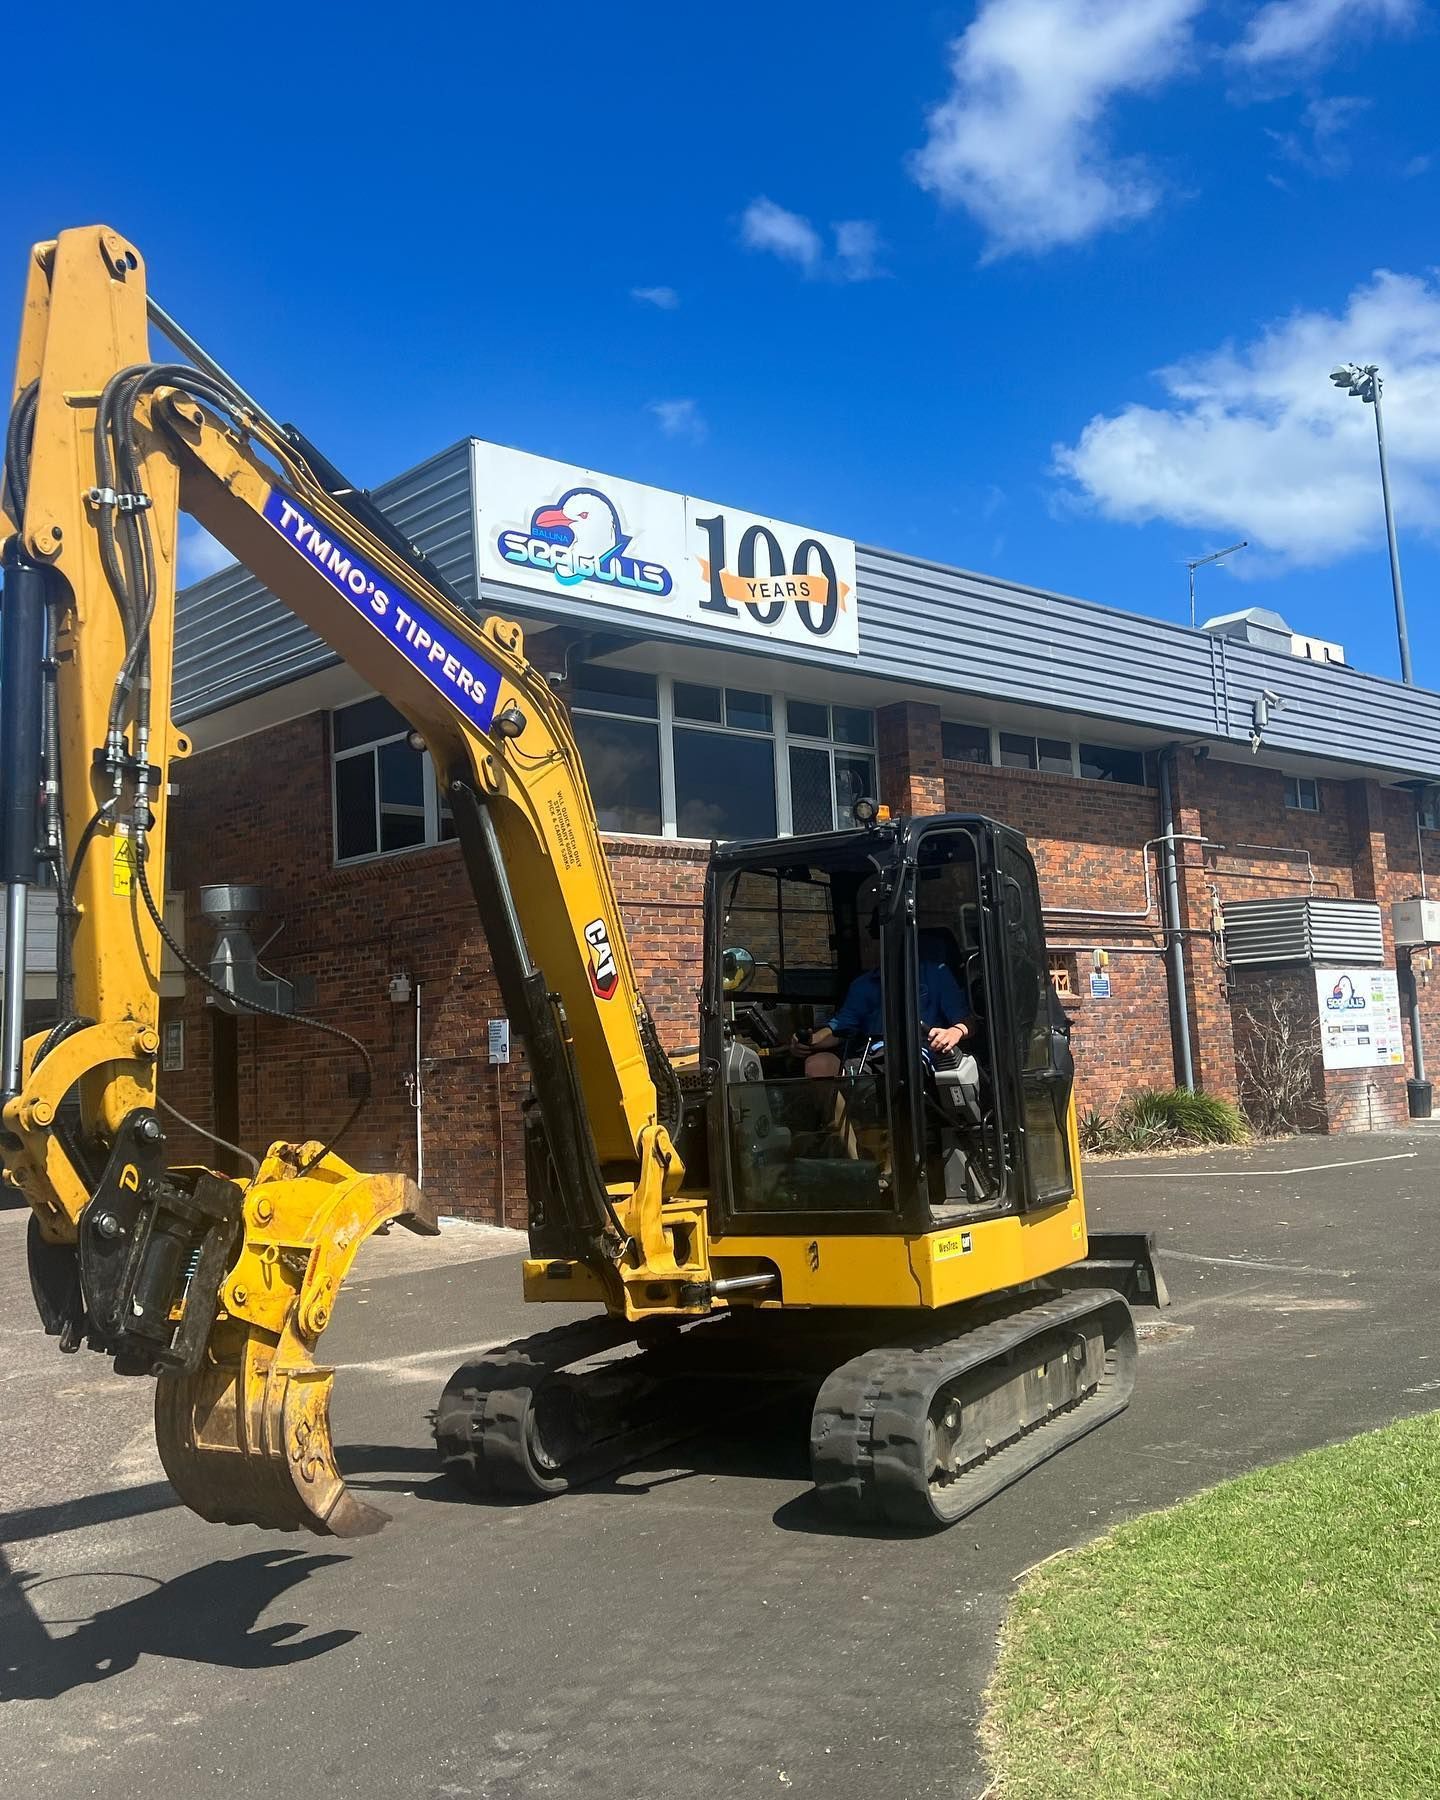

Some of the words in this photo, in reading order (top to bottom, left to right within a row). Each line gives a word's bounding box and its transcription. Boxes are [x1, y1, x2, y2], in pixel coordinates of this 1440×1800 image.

[532, 528, 569, 543] BALLINA
[279, 500, 390, 615] TYMMO'S
[393, 606, 487, 705] TIPPERS
[695, 514, 837, 635] 100
[747, 581, 812, 598] YEARS
[585, 919, 616, 979] CAT
